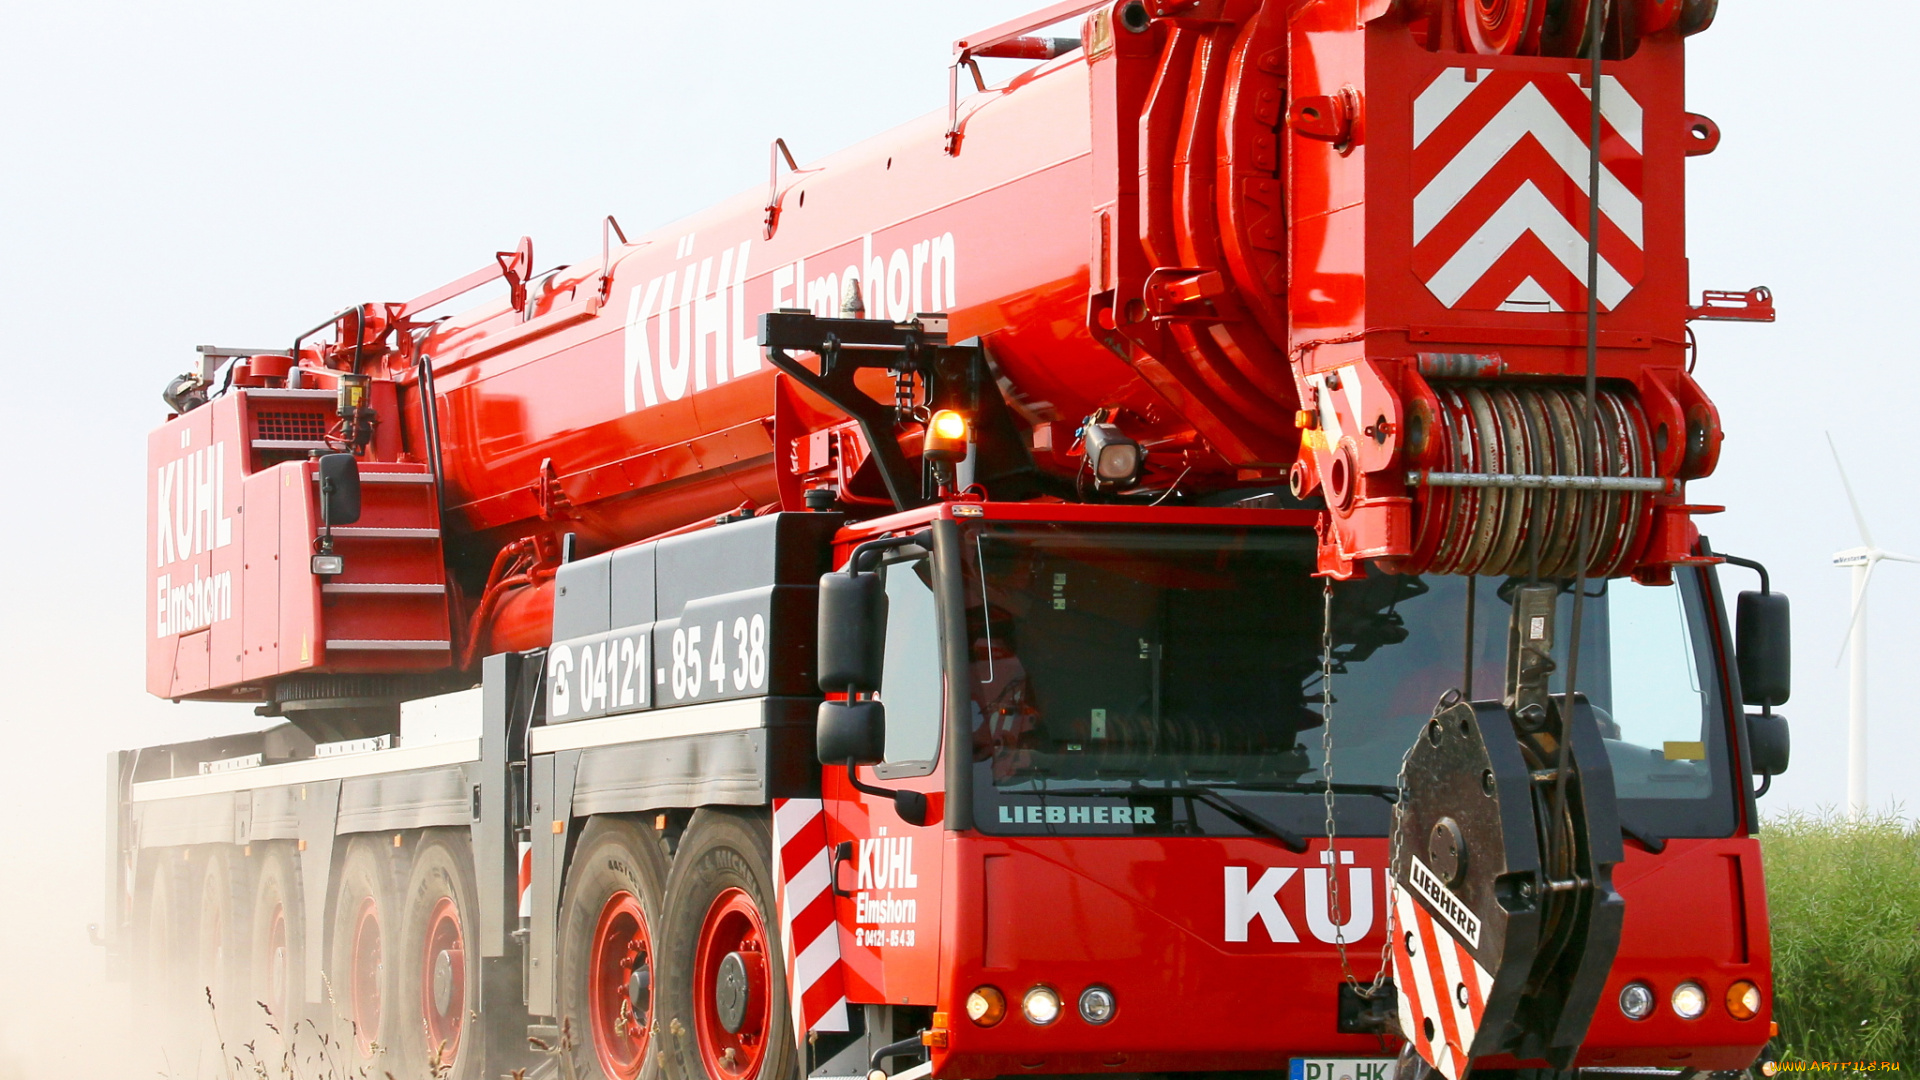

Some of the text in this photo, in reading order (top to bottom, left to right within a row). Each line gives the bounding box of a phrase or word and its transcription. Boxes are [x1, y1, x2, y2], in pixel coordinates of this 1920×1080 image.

[624, 231, 956, 414] KÜHL Elmhorn
[157, 428, 232, 568] KÜHL
[157, 563, 232, 639] Elmshorn
[579, 634, 646, 713] 04121
[672, 626, 702, 700] 85
[709, 620, 726, 694] 4
[732, 613, 766, 691] 38
[998, 805, 1157, 825] LIEBHERR
[857, 826, 918, 890] KÜHL
[855, 891, 917, 924] Elmshorn
[1413, 862, 1478, 941] LIEBHERR
